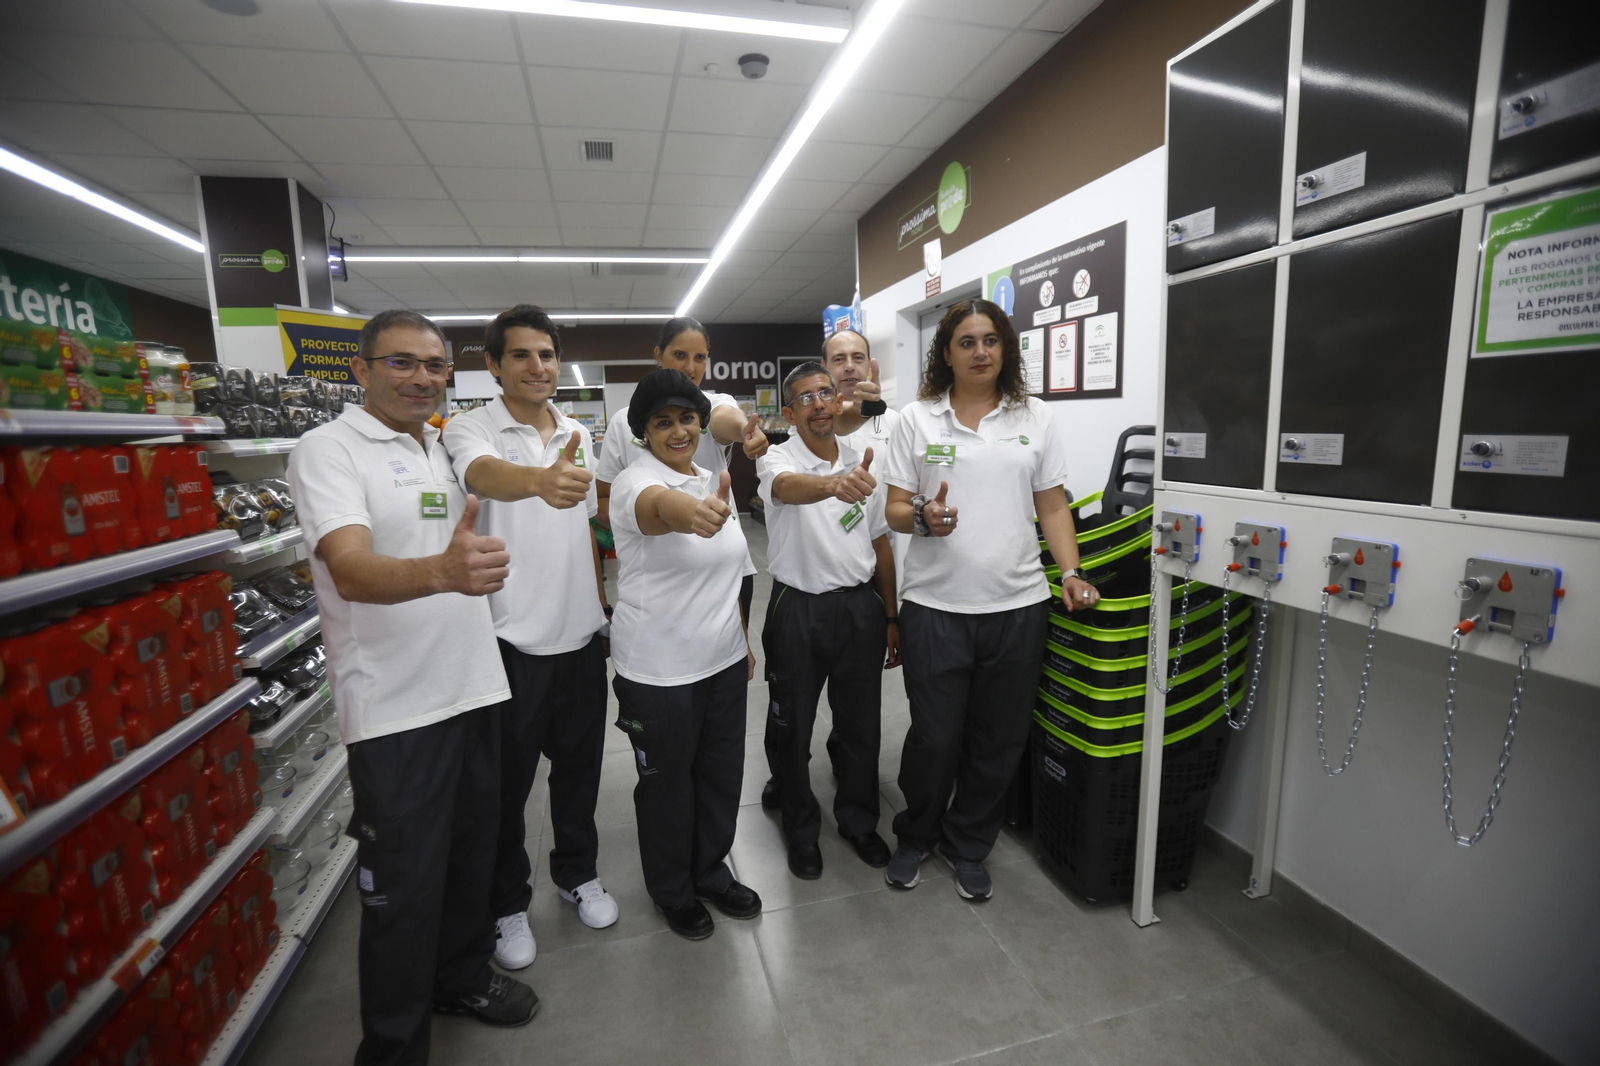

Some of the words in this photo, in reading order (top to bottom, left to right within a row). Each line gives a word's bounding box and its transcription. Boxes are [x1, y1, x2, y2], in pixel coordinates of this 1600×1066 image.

[900, 204, 937, 243] prossima
[1086, 239, 1106, 252] vigente
[1507, 246, 1543, 261] NOTA
[221, 256, 260, 265] prossima
[1508, 265, 1528, 275] LES
[1530, 254, 1591, 271] ROGAMOS
[1498, 265, 1583, 287] PERTENENCIAS
[1517, 286, 1524, 295] Y
[1527, 278, 1584, 294] COMPRAS
[0, 276, 98, 335] tería
[1517, 301, 1533, 310] LA
[62, 346, 71, 359] 6
[300, 338, 359, 353] PROYECTO
[139, 358, 146, 369] 6
[182, 370, 191, 389] 2
[304, 369, 349, 381] EMPLEO
[70, 388, 80, 400] 6
[146, 394, 154, 405] 6
[176, 481, 203, 495] AMSTEL
[81, 489, 121, 507] AMSTEL
[215, 631, 226, 672] AMSTEL
[156, 658, 171, 705] AMSTEL
[75, 700, 97, 755] AMSTEL
[236, 767, 248, 807] AMSTEL
[185, 813, 198, 856] AMSTEL
[112, 873, 132, 925] AMSTEL
